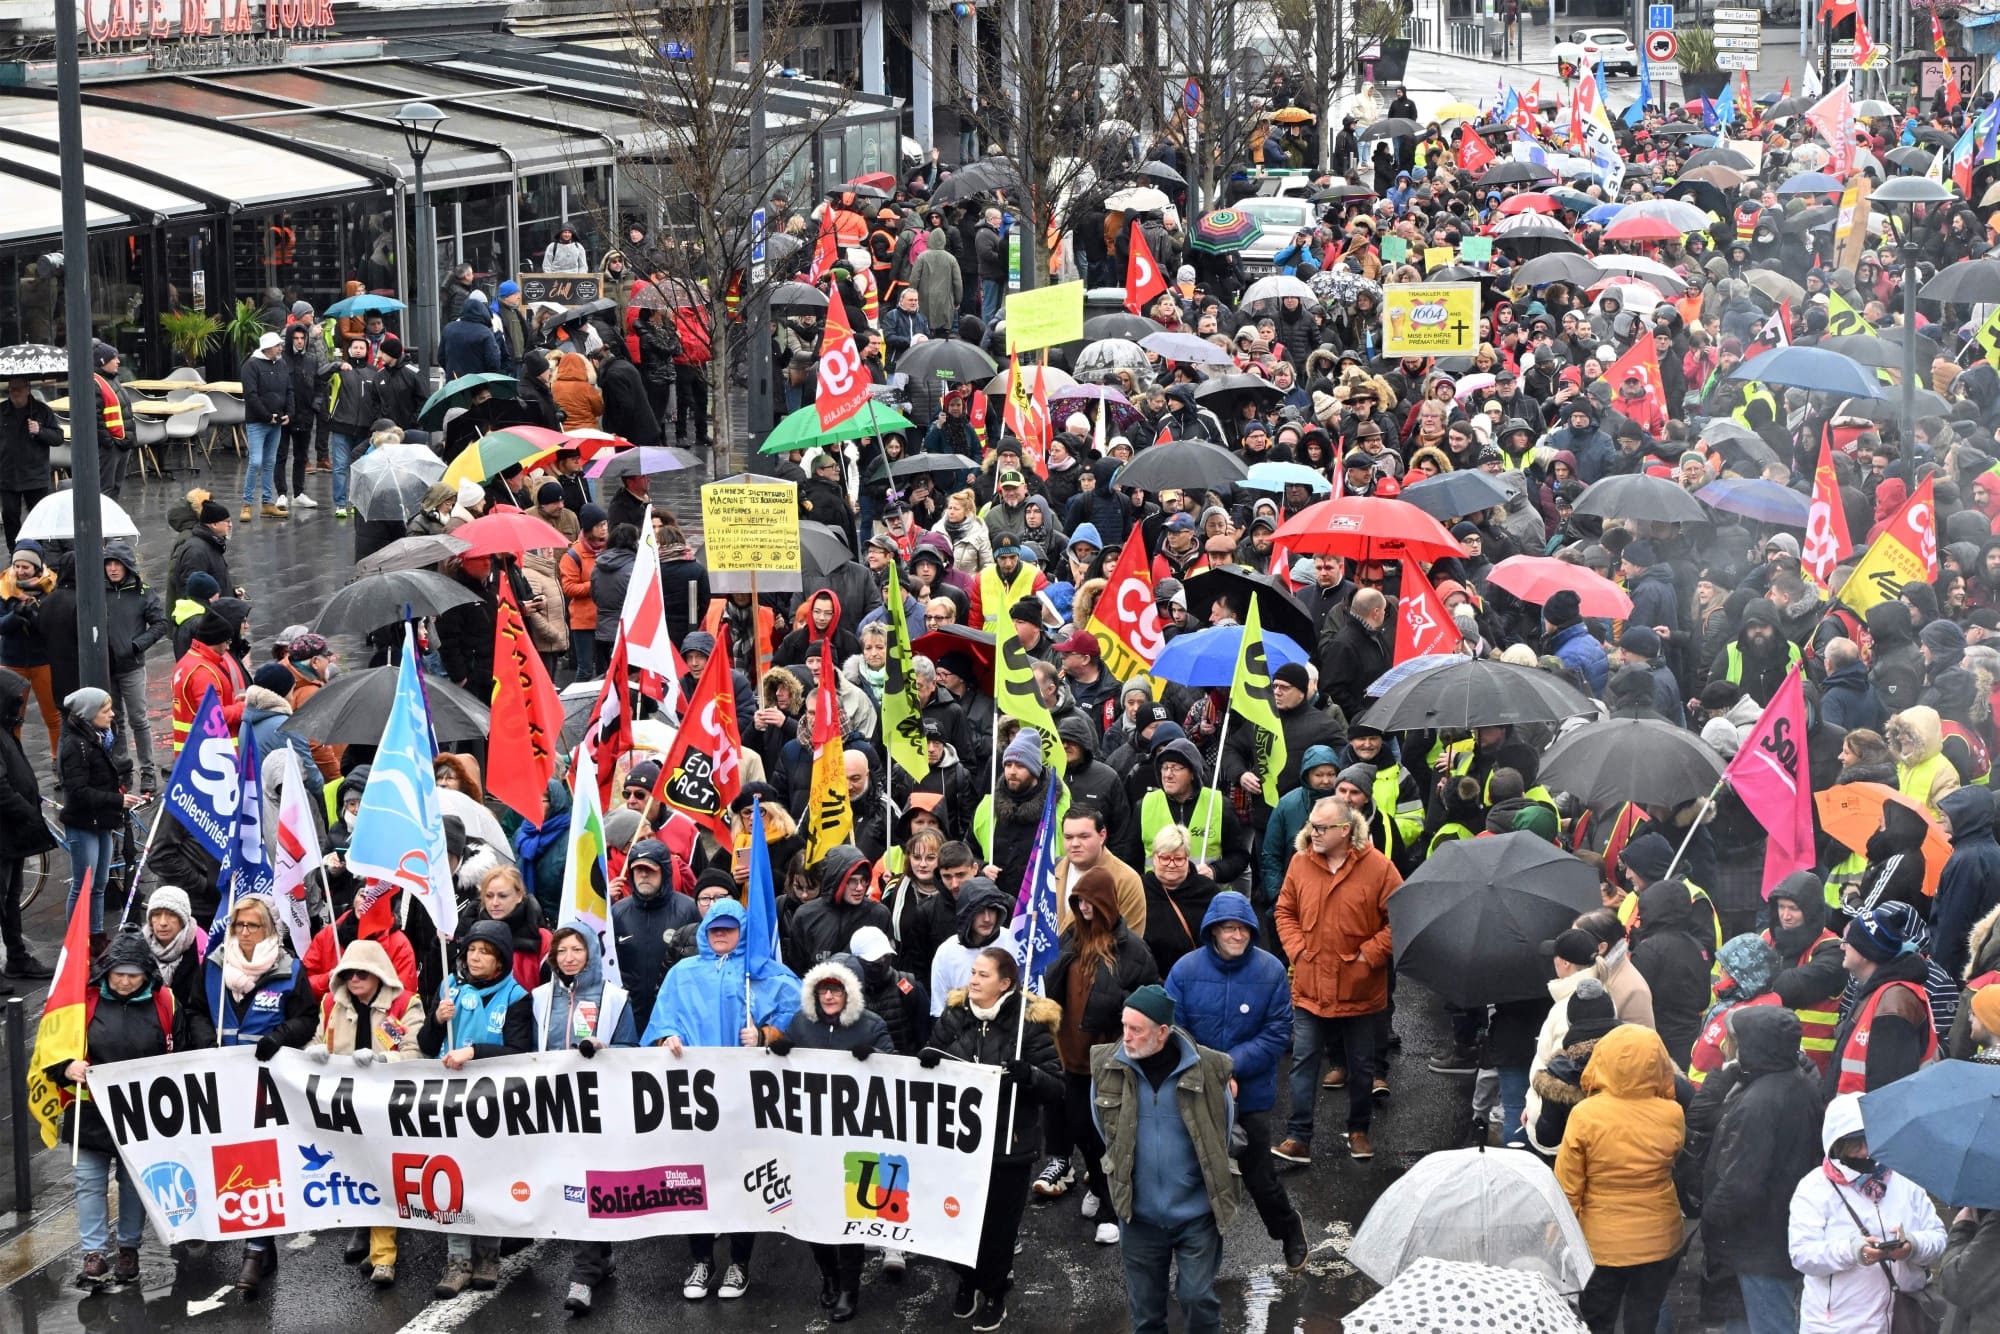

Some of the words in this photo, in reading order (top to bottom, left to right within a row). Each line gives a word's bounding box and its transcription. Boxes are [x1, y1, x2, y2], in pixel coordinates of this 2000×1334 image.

[181, 0, 213, 35] DE
[221, 0, 251, 33] LA
[1413, 307, 1444, 320] 1664
[709, 496, 738, 505] MACRON
[170, 782, 230, 851] Collectivités
[107, 1071, 222, 1146] NON
[253, 1066, 289, 1128] A
[305, 1074, 363, 1135] LA
[388, 1071, 602, 1138] REFORME
[632, 1069, 719, 1133] DES
[750, 1069, 983, 1154] RETRAITES
[218, 1164, 281, 1193] la
[303, 1171, 382, 1208] cftc
[391, 1152, 465, 1225] FO
[665, 1170, 688, 1180] Union
[666, 1176, 702, 1188] syndicale
[743, 1158, 778, 1193] CFE
[217, 1178, 287, 1227] cgt
[399, 1202, 409, 1216] la
[410, 1203, 433, 1220] force
[433, 1208, 476, 1225] syndicale
[590, 1178, 704, 1214] Solidaires
[843, 1221, 915, 1243] F.S.U.
